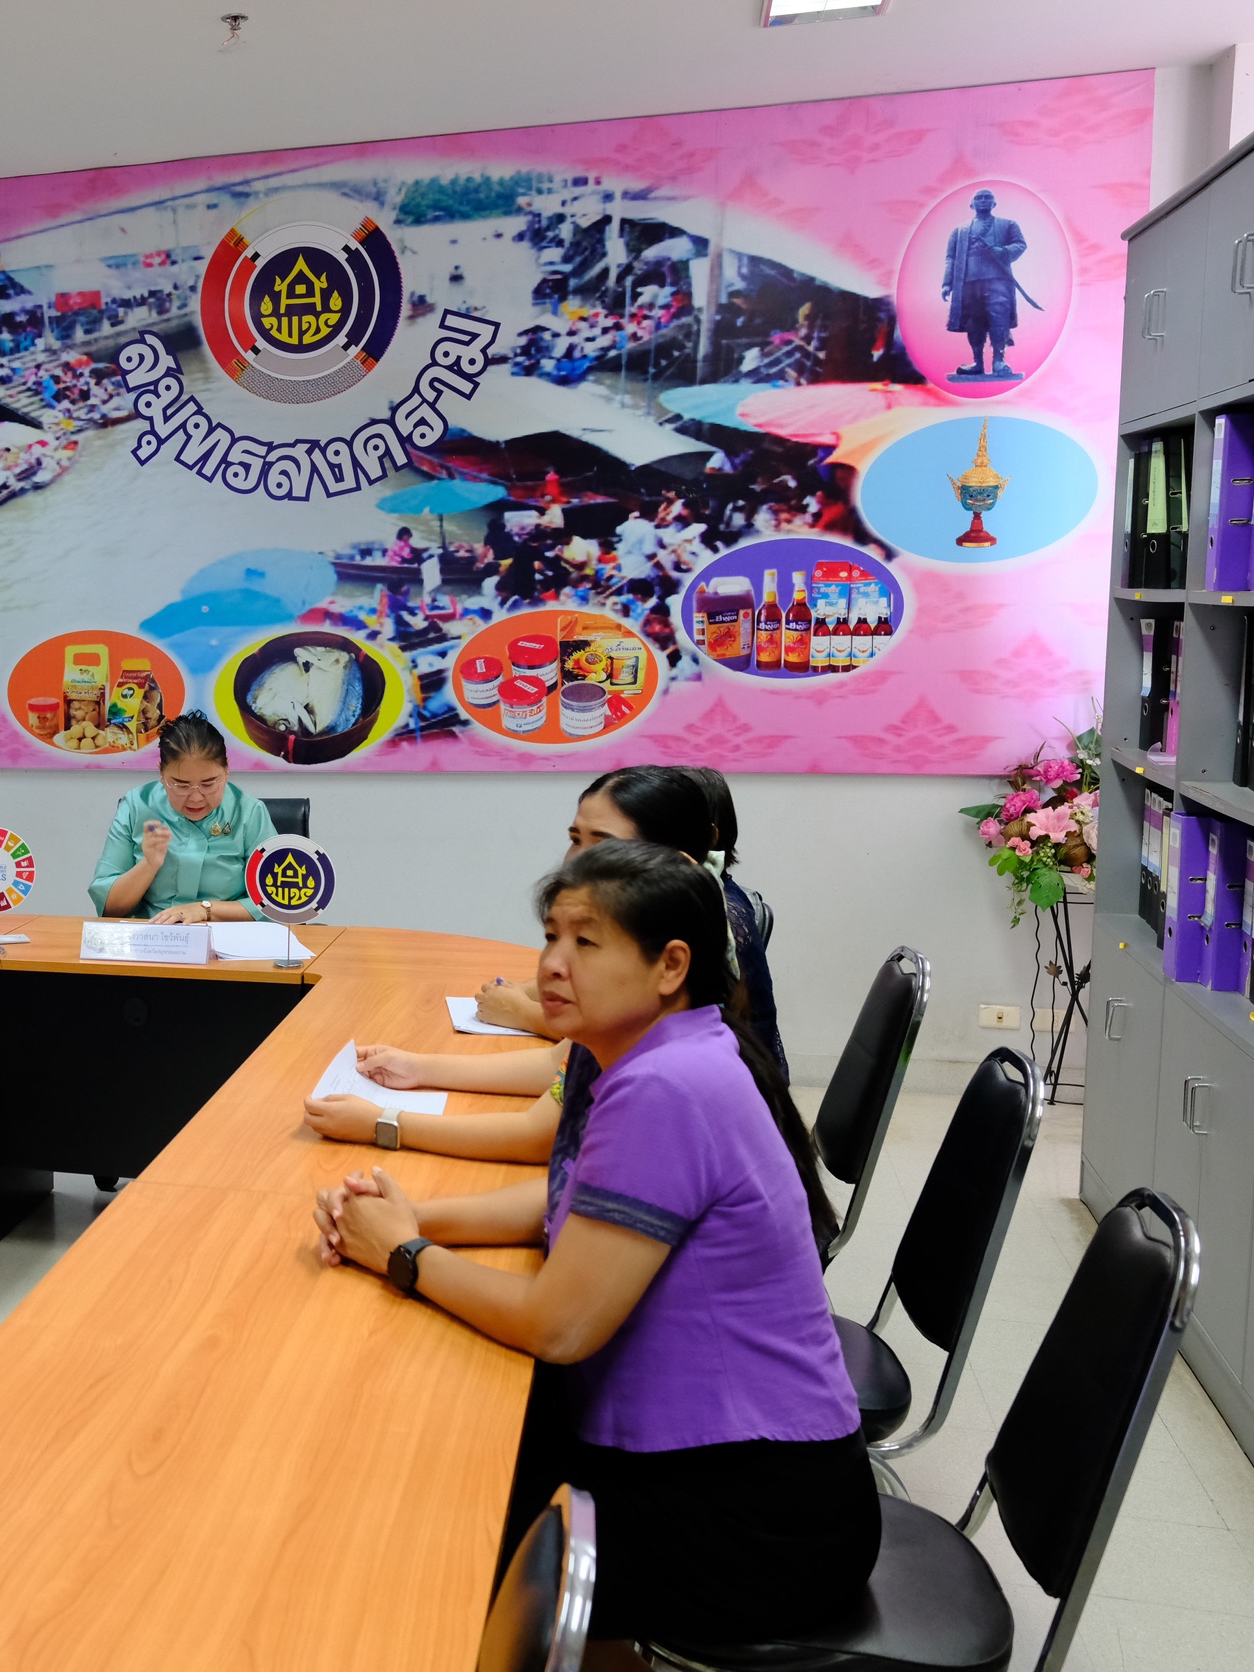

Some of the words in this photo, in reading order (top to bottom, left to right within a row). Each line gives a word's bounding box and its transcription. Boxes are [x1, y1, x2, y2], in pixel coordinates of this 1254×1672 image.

[117, 308, 501, 502] สมุทรสงคราม
